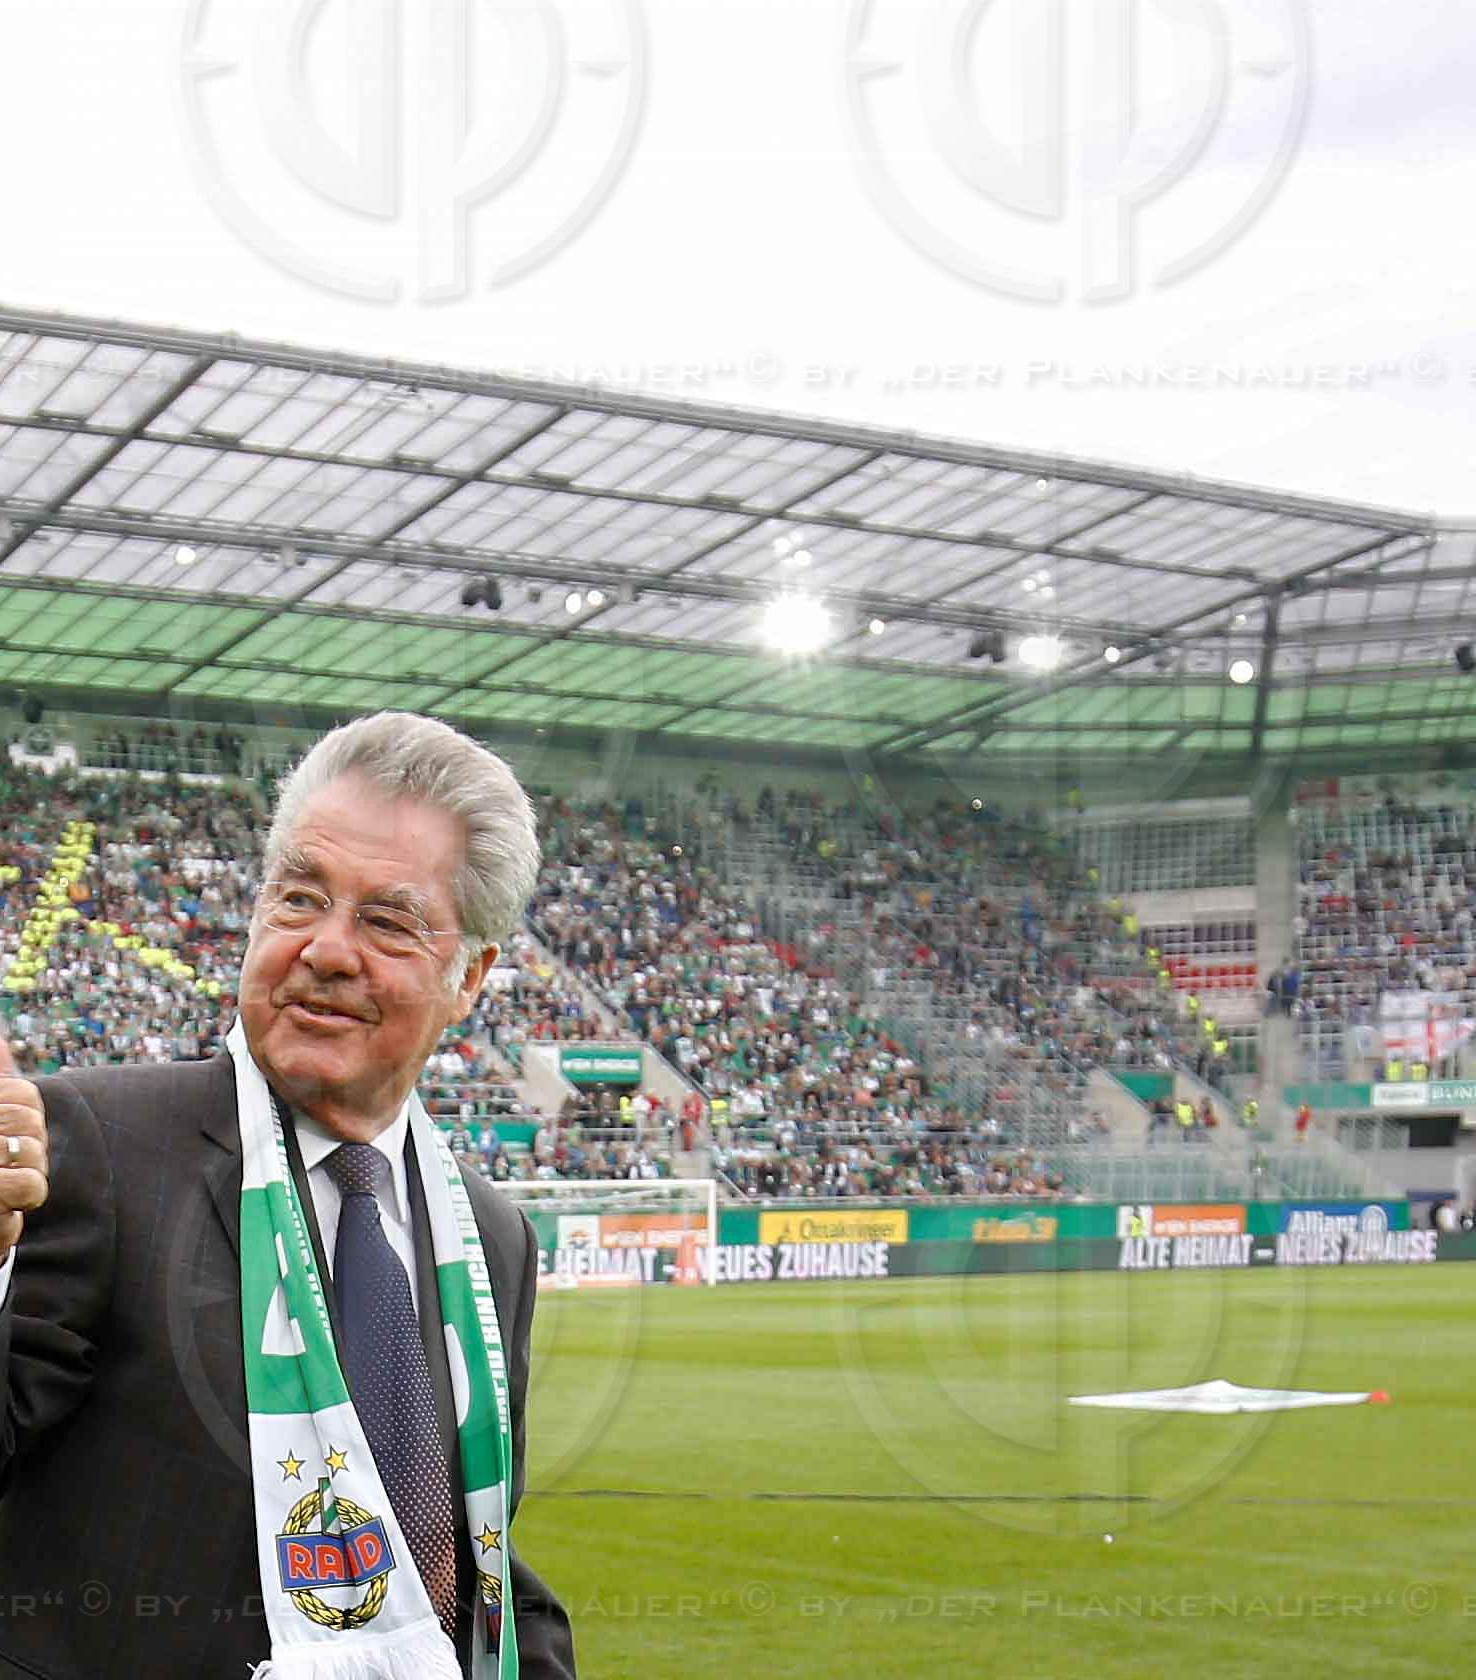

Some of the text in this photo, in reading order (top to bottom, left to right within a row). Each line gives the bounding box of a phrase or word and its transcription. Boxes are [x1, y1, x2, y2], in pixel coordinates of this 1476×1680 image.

[776, 1242, 890, 1280] ZUHAUSE
[1118, 1234, 1172, 1269] ALTE
[1173, 1233, 1254, 1267] HEIMAT
[1277, 1231, 1345, 1265] NEUES
